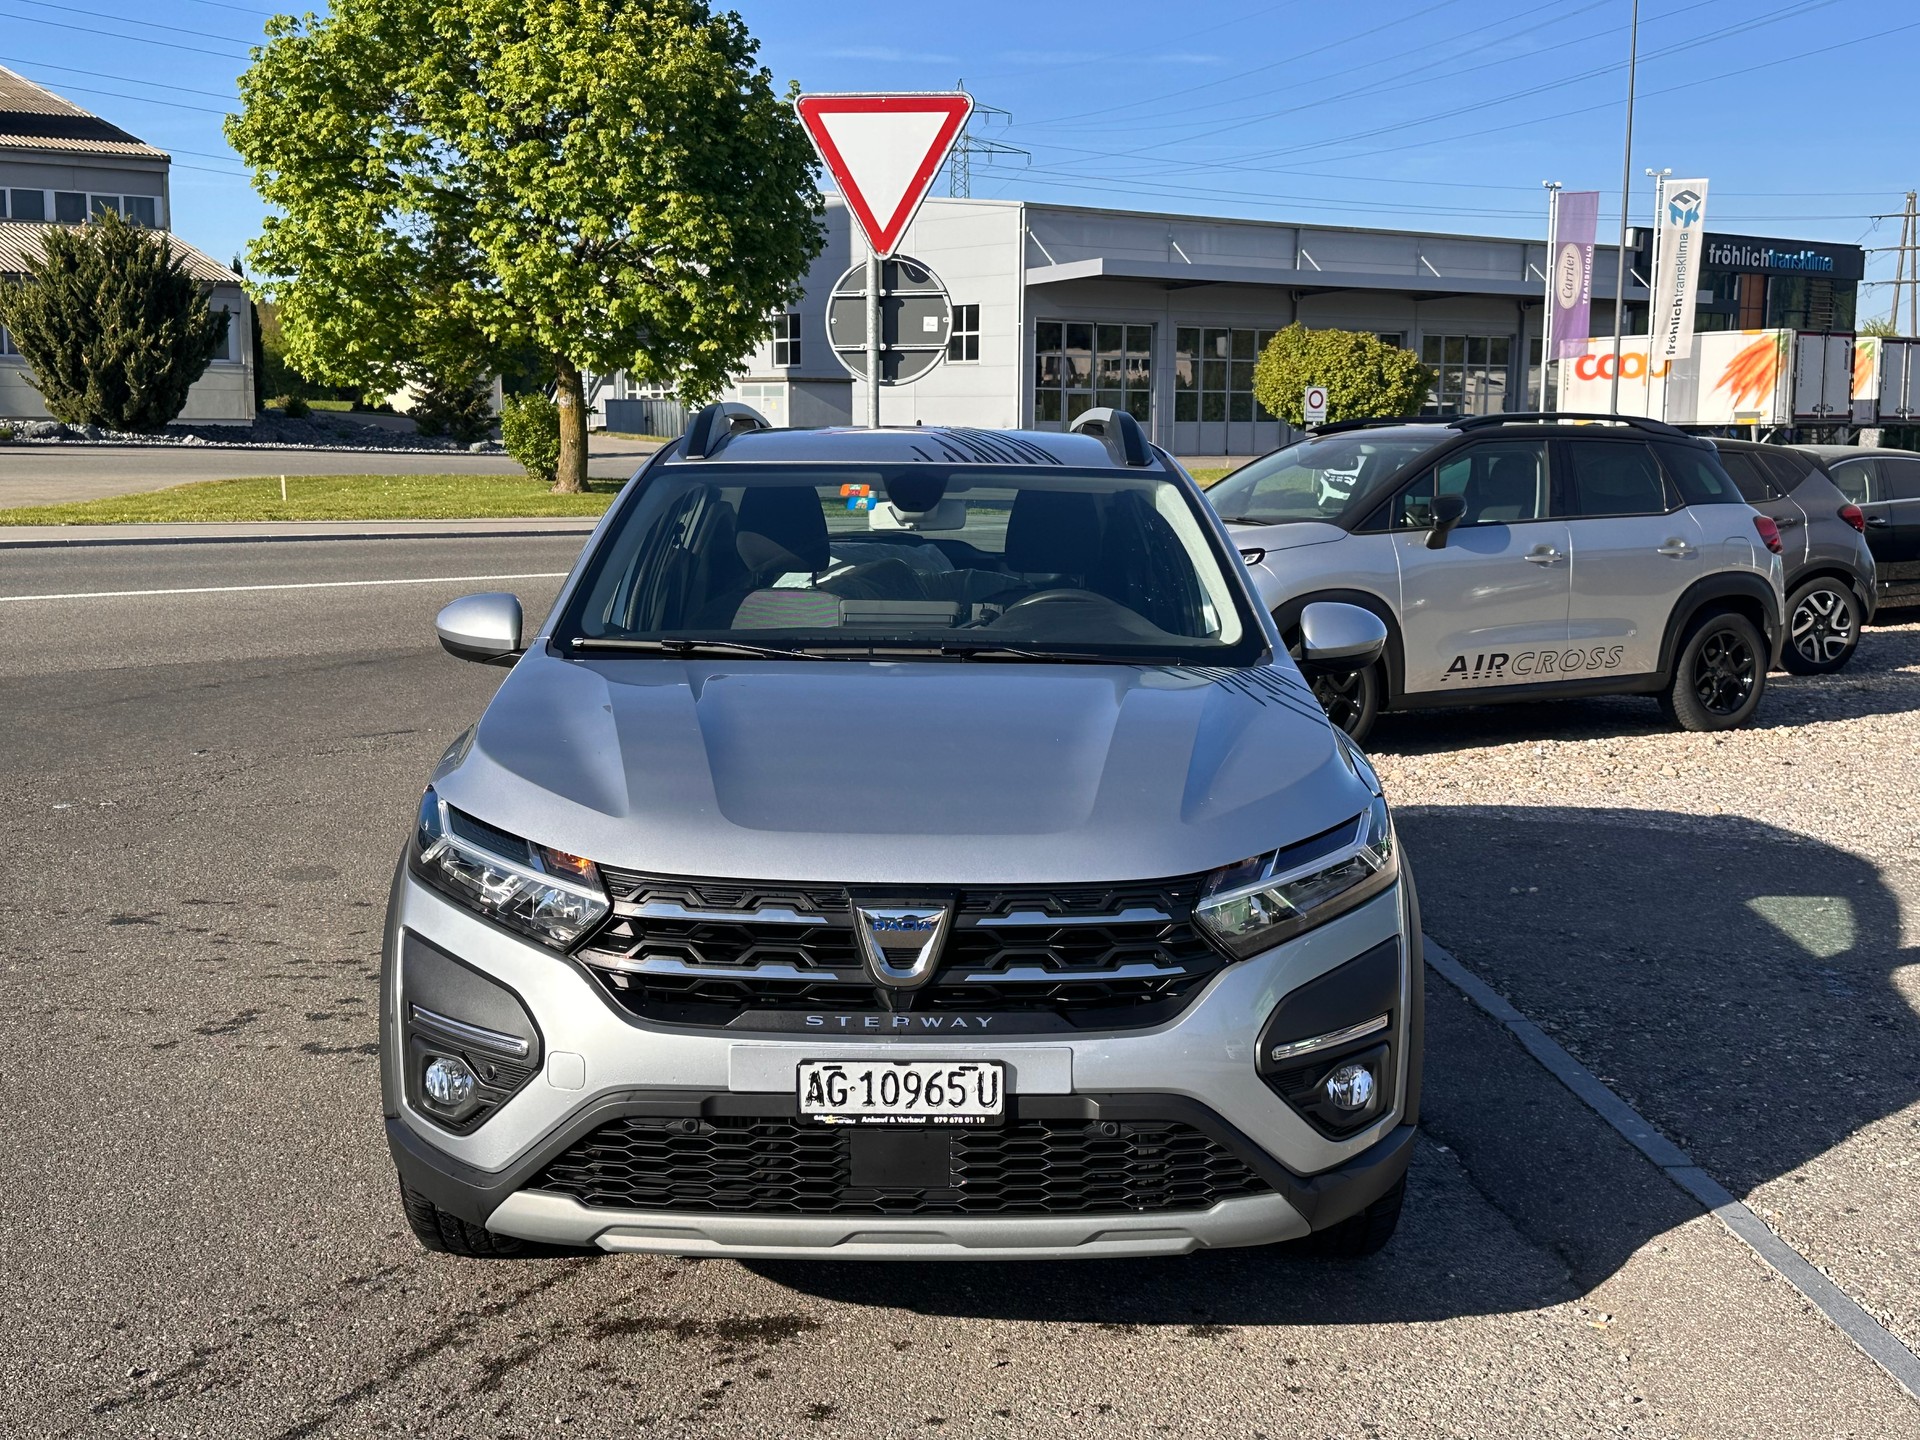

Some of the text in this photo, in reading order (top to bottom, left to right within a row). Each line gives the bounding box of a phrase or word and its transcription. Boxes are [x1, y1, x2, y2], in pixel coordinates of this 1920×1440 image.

[1562, 252, 1577, 299] Carrier
[1440, 646, 1624, 682] AIRCROSS
[872, 919, 932, 932] DACIA
[805, 1015, 993, 1028] STEPWAY
